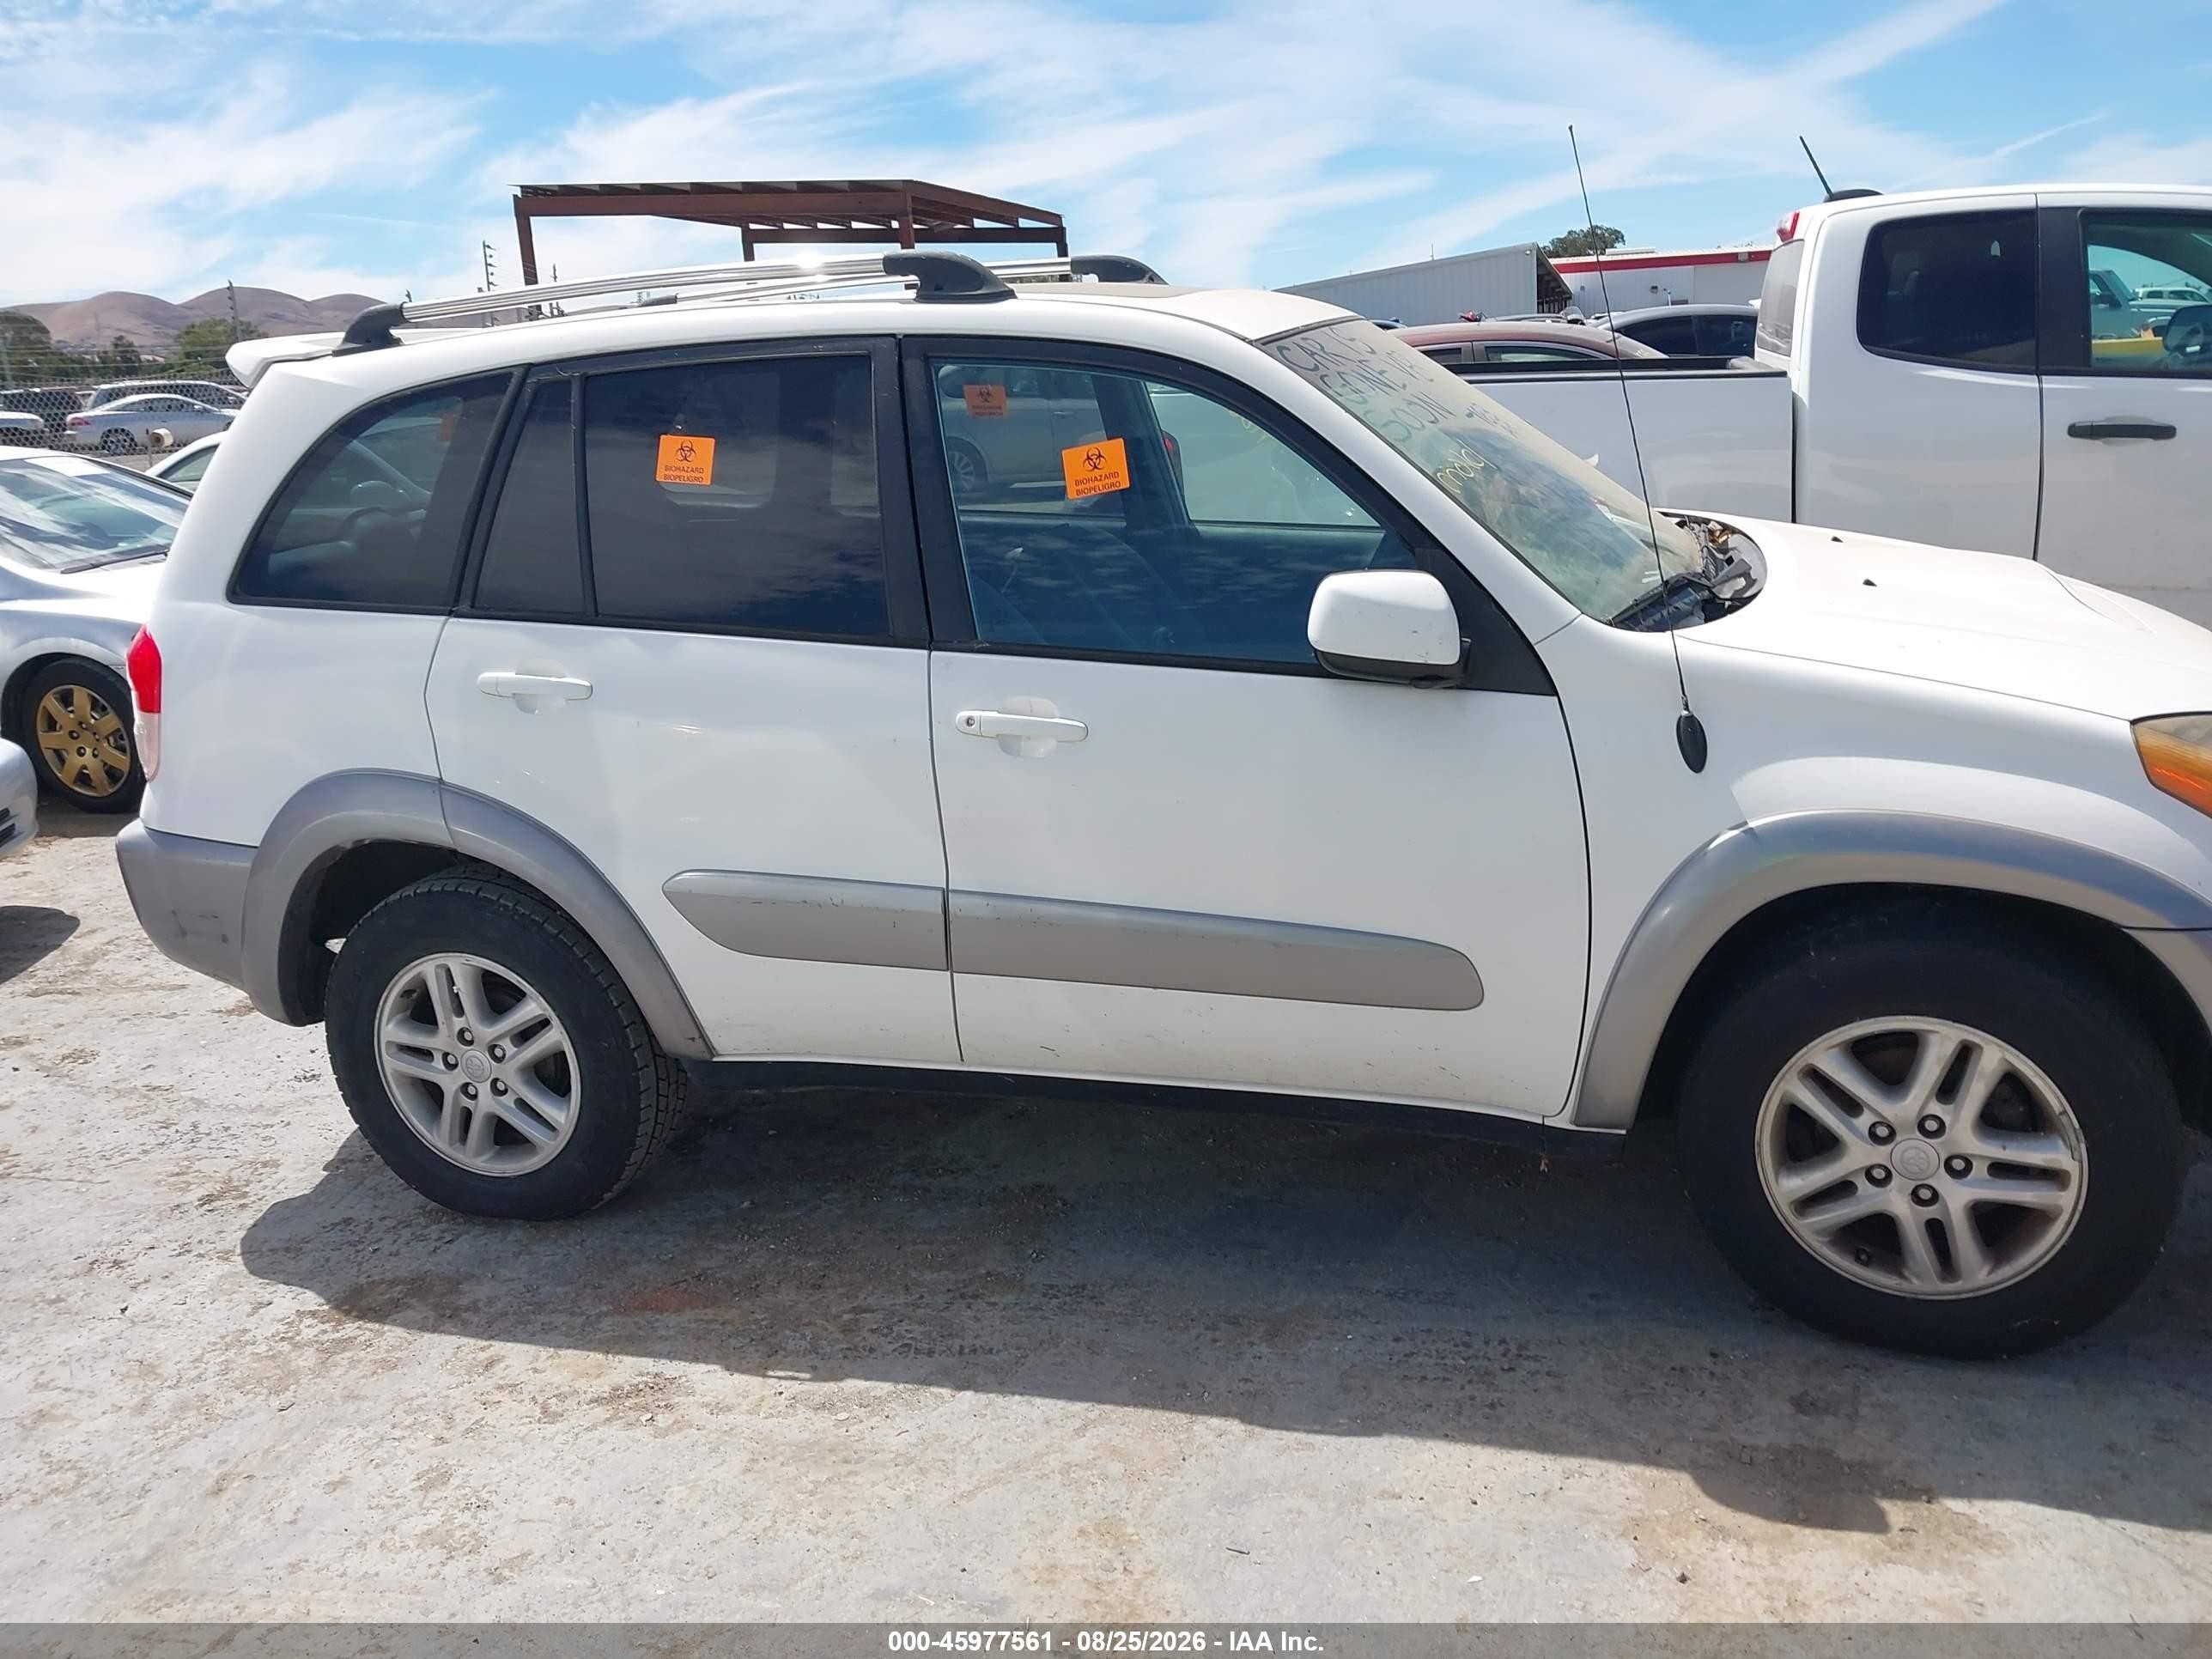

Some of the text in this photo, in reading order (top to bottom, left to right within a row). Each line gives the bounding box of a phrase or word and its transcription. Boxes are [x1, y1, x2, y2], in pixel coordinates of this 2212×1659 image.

[1276, 327, 1377, 372] CAR IS
[1319, 359, 1407, 404] GONE
[1363, 391, 1457, 442] SOON
[663, 473, 704, 483] BIOPELIGRO
[665, 465, 705, 474] BIOHAZARD
[1074, 471, 1120, 488] BIOHAZARD
[1075, 480, 1122, 496] BIOPELIGRO
